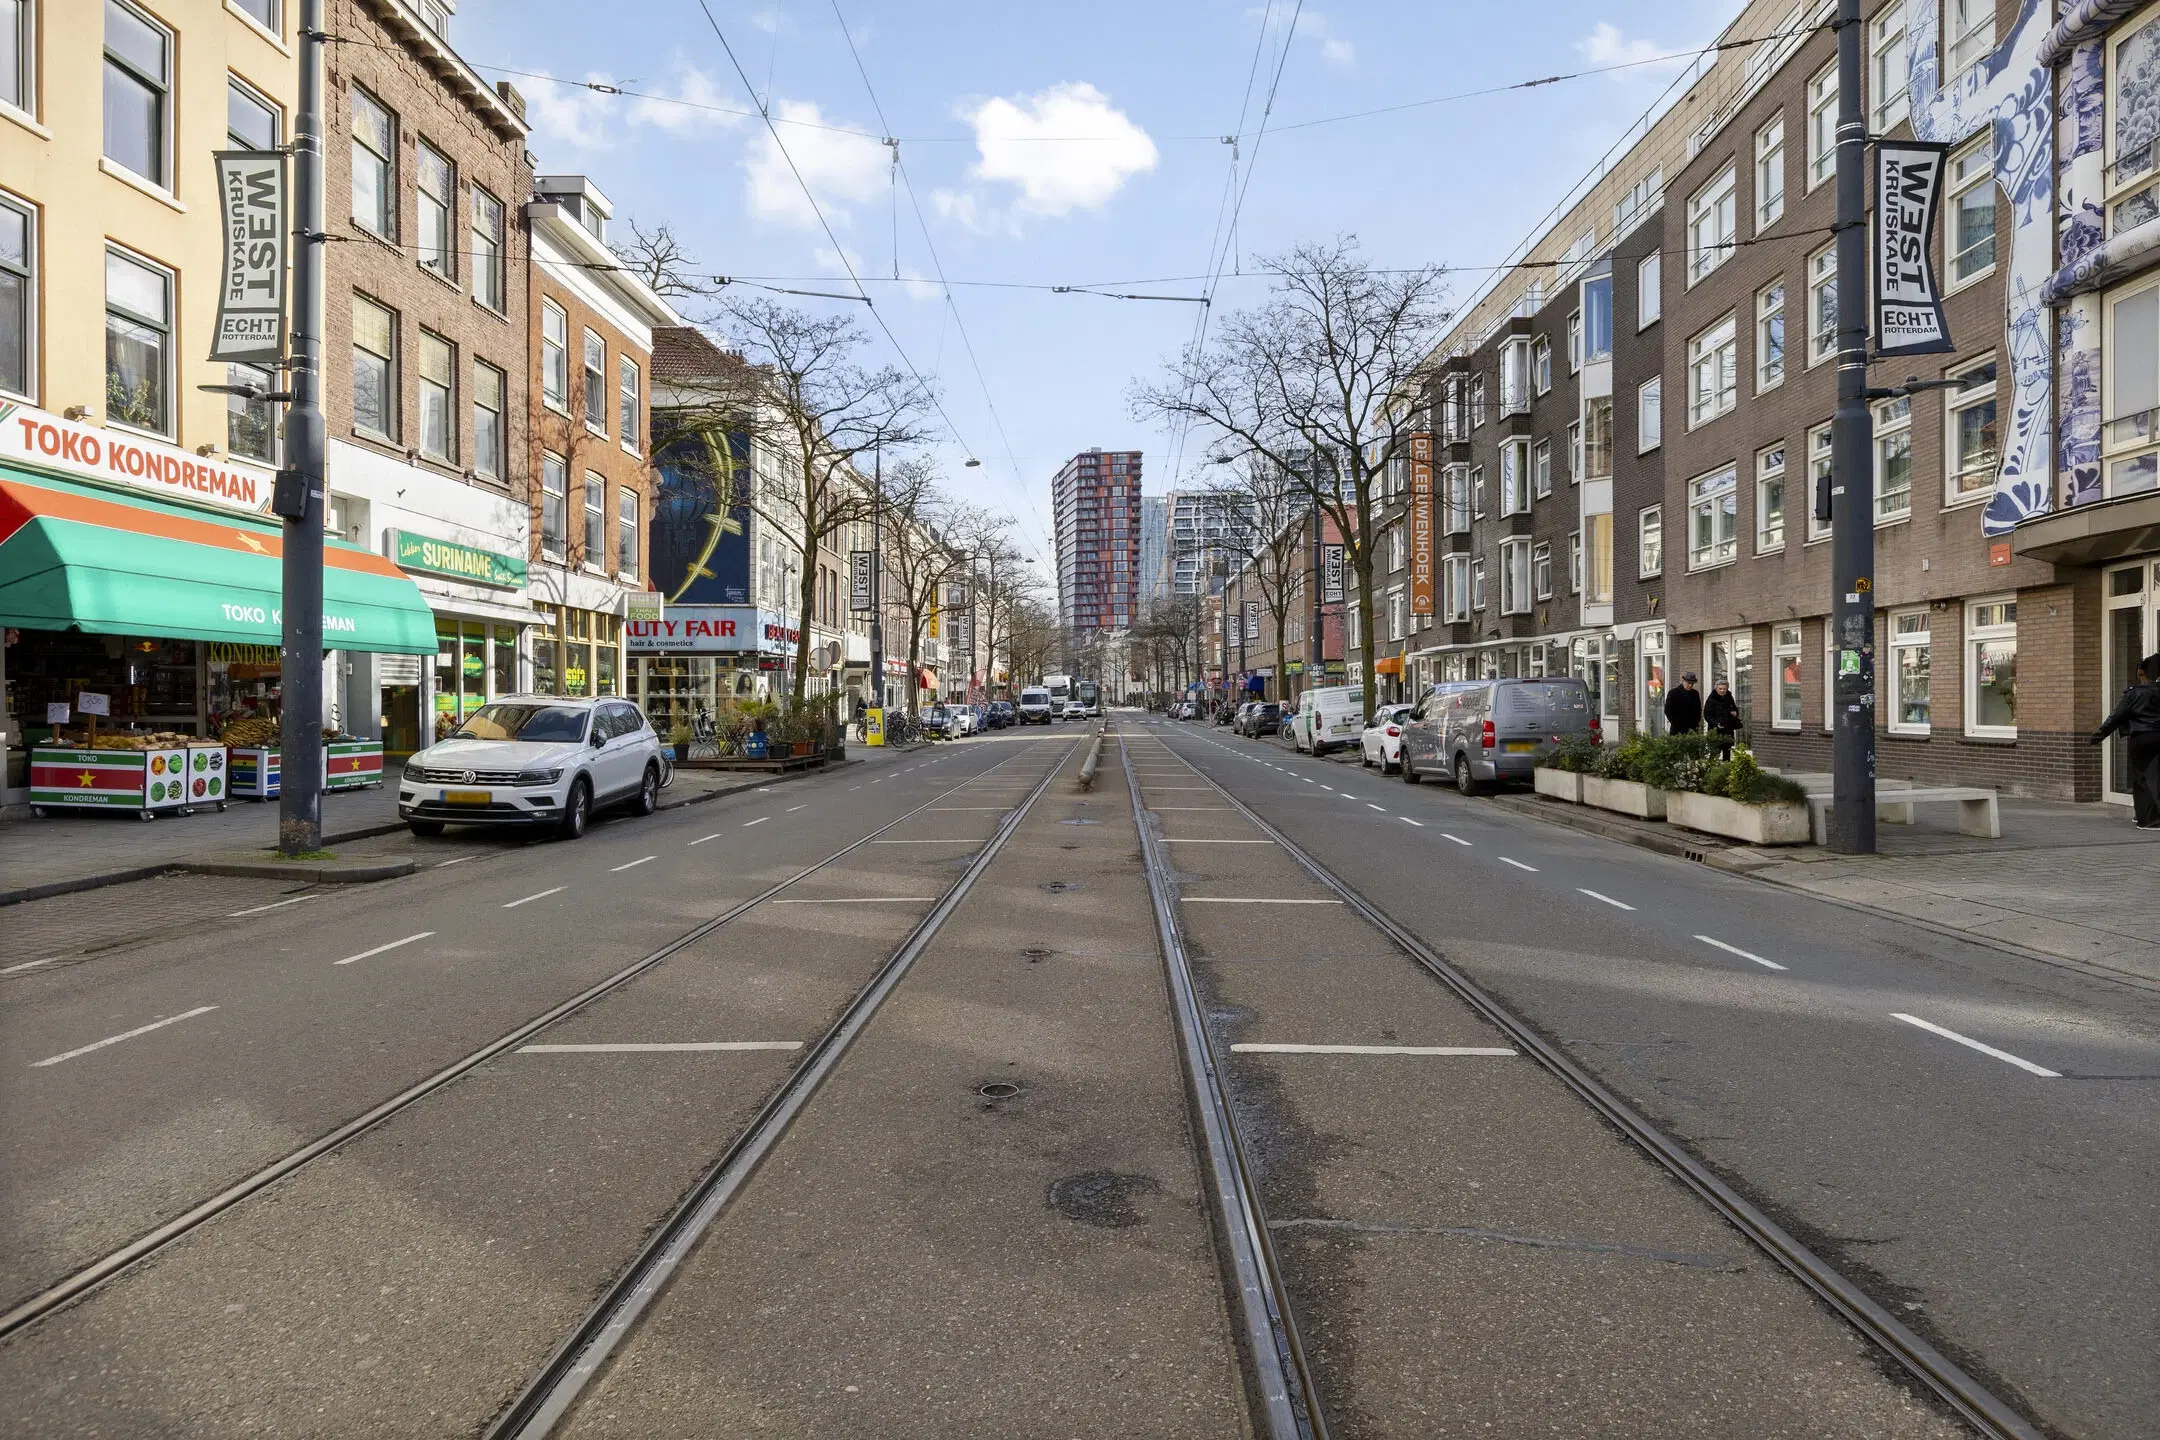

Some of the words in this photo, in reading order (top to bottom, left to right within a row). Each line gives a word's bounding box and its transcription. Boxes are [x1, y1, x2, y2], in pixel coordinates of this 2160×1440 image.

[228, 171, 245, 300] KRUISKADE
[1886, 160, 1899, 292] KRUISKADE
[223, 318, 277, 333] ECHT
[1884, 311, 1934, 326] ECHT
[222, 333, 275, 341] ROTTERDAM
[1885, 326, 1938, 334] ROTTERDAM
[1416, 438, 1428, 460] DE
[18, 417, 100, 466] TOKO
[109, 442, 256, 504] KONDREMAN
[1416, 464, 1429, 585] LEEUWENHOEK
[422, 542, 492, 578] SURINAME
[222, 604, 266, 624] TOKO
[272, 609, 356, 631] KEMAN
[685, 620, 736, 637] FAIR
[63, 794, 109, 803] KONDREMAN
